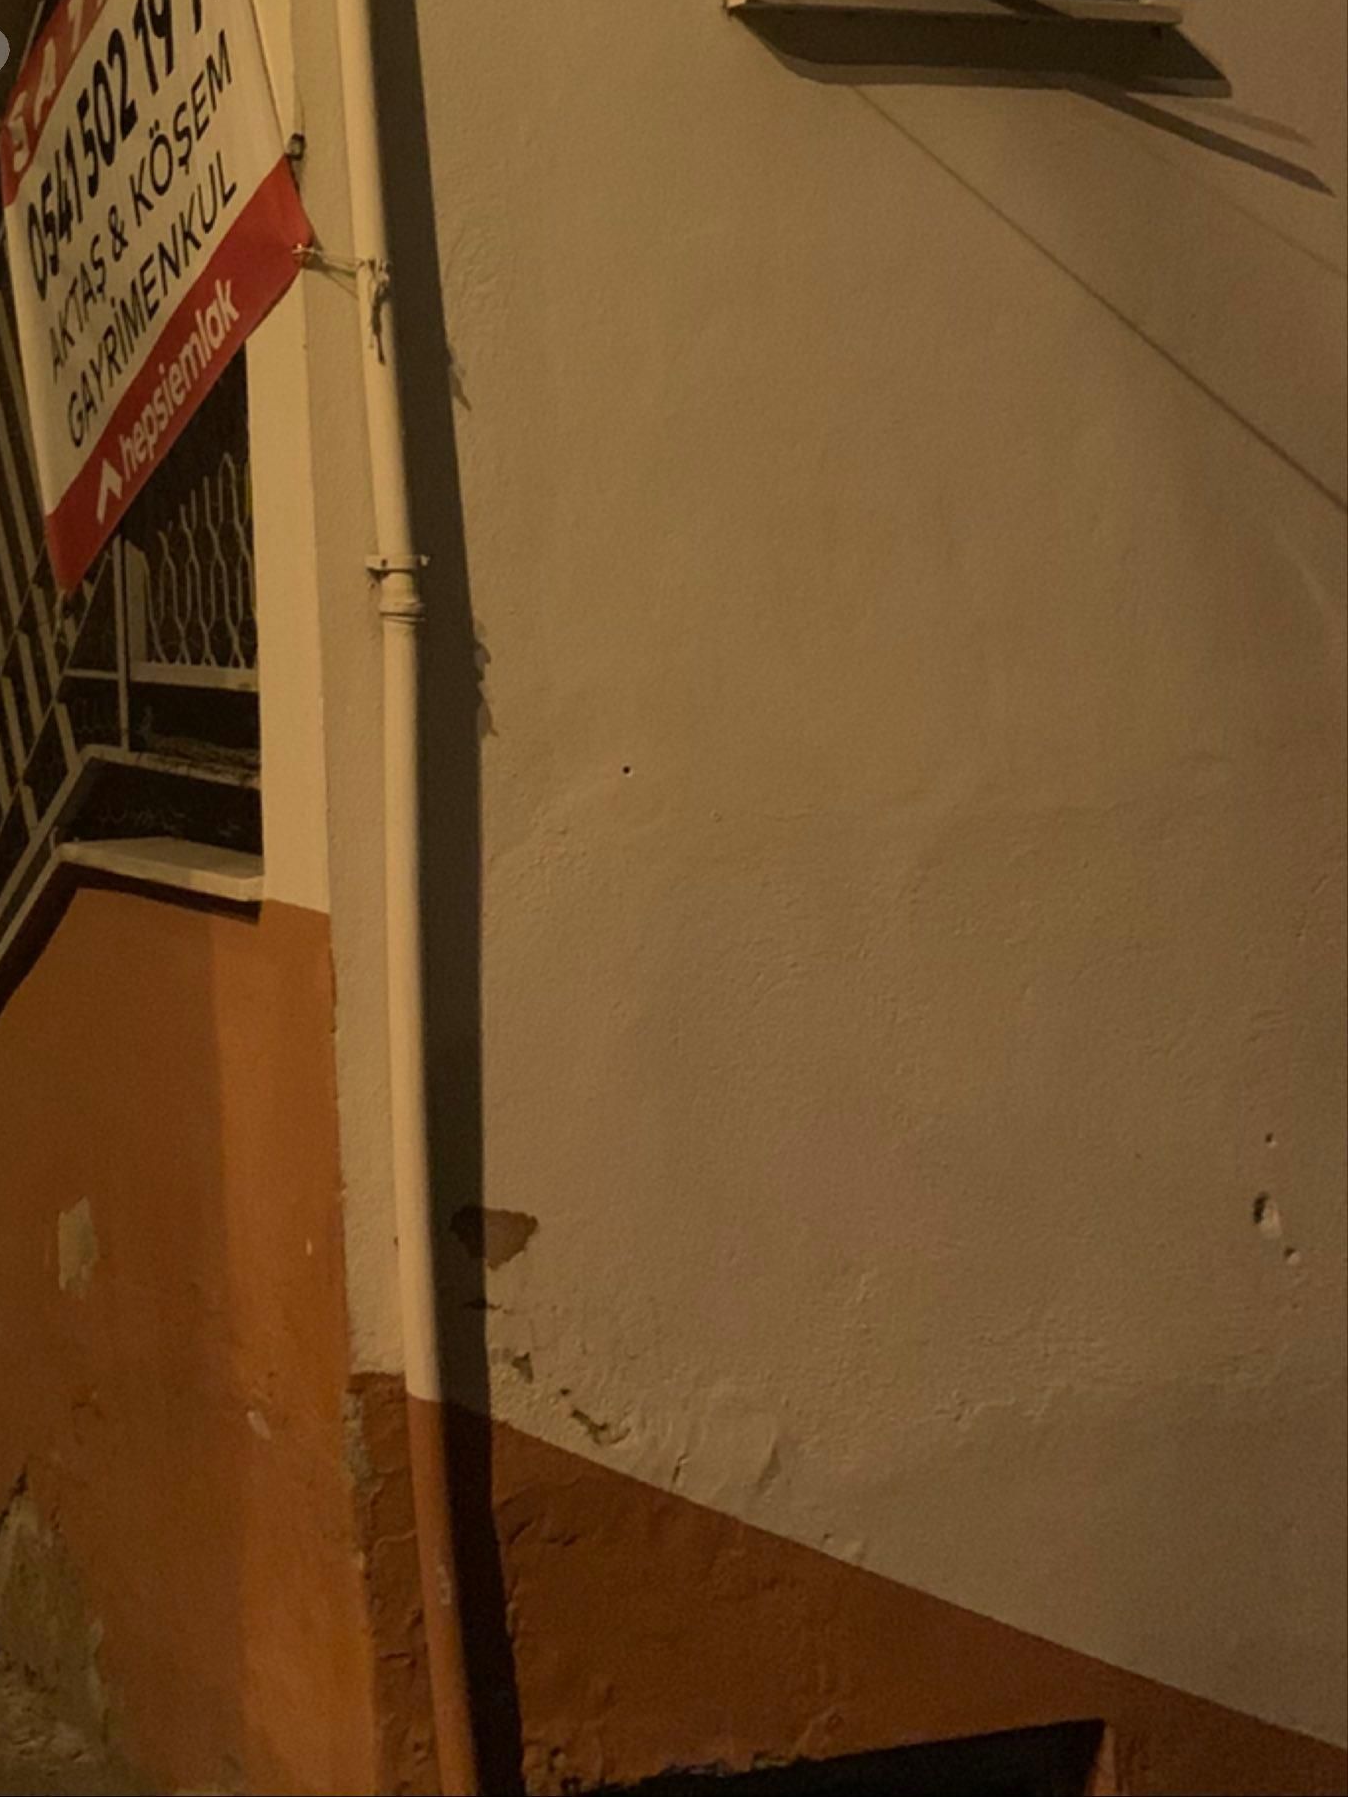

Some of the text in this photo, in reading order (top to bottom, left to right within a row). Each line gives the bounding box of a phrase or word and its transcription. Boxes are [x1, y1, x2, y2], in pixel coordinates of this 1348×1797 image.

[27, 126, 83, 299] 0541
[76, 28, 138, 197] 502
[51, 29, 232, 383] AKTAŞ & KÖŞEM
[67, 151, 237, 448] GAYRİMENKUL
[119, 279, 241, 482] hepsiemlak
